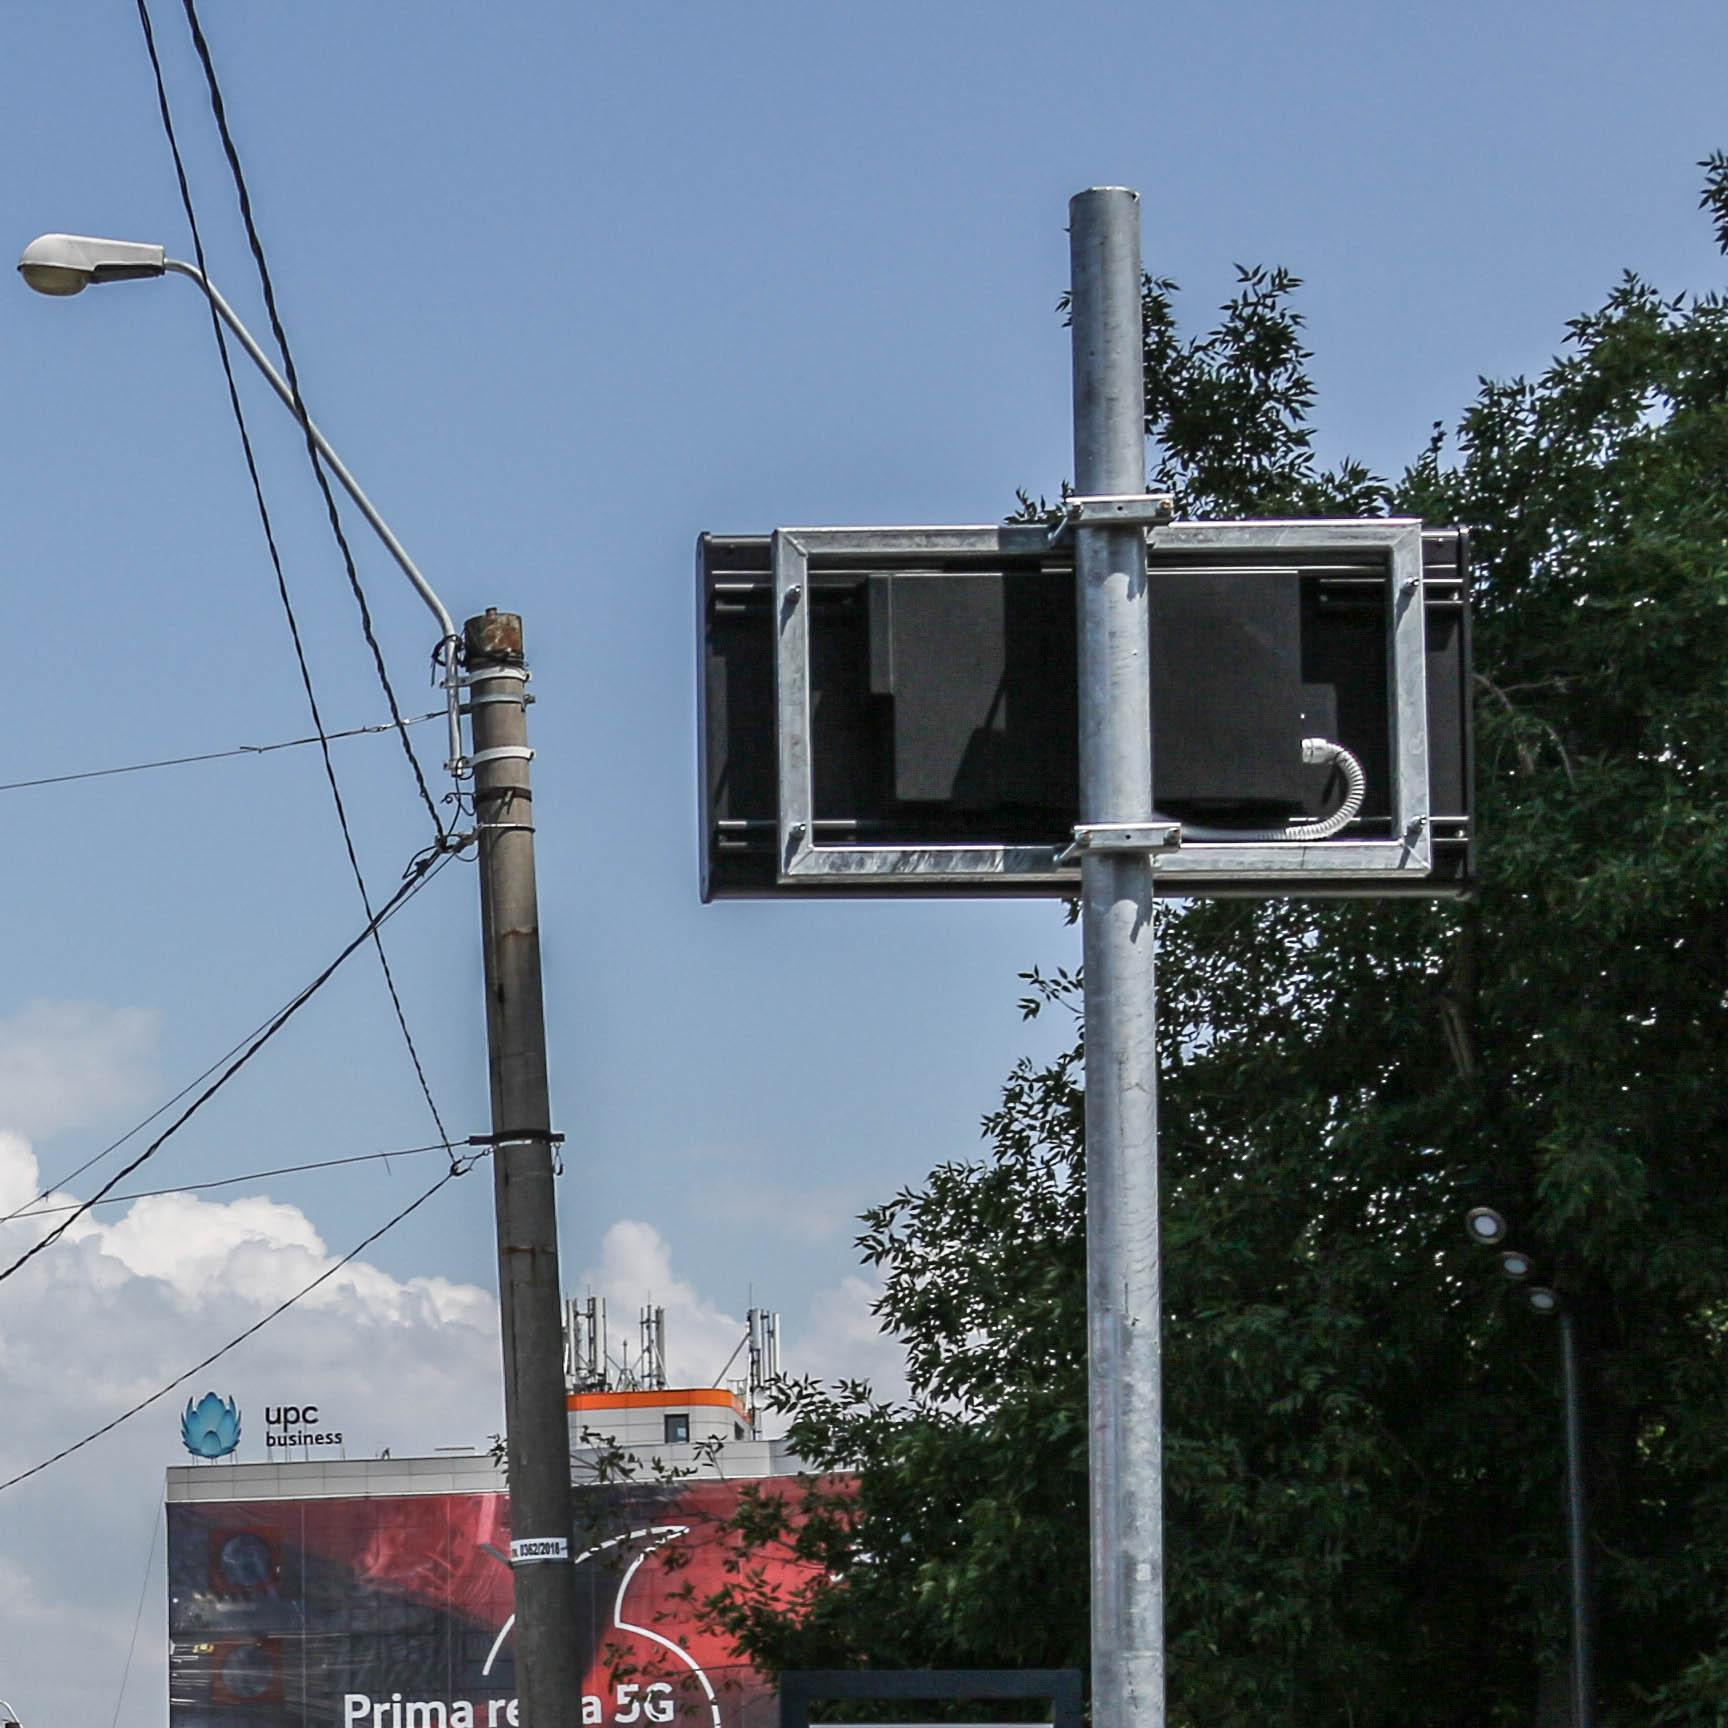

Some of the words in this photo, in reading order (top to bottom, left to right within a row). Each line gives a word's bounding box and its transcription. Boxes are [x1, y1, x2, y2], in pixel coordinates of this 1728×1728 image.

[265, 1406, 319, 1432] upc
[266, 1430, 342, 1447] business
[614, 1683, 675, 1723] 5G
